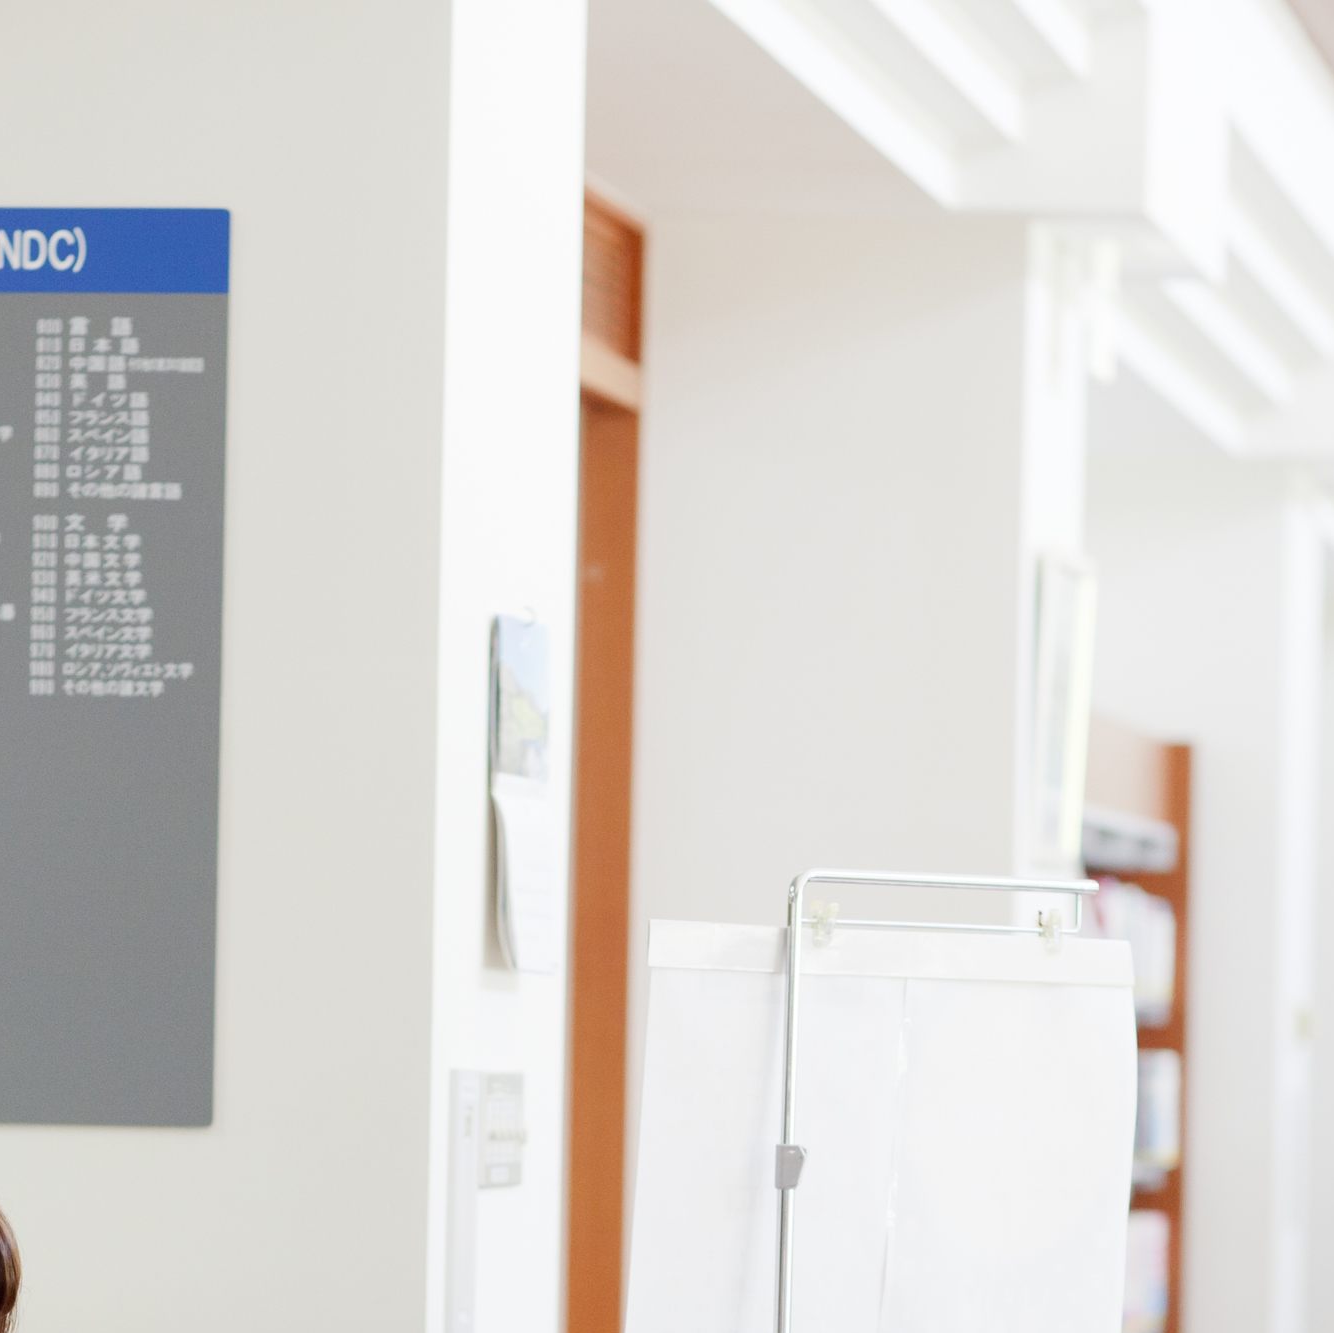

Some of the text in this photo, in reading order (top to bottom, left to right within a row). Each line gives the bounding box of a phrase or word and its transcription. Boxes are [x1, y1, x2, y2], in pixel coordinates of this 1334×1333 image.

[67, 392, 150, 409] ドイツ語
[67, 410, 150, 428] フランス語
[66, 426, 150, 445] スペイン語
[65, 514, 129, 532] 文学
[65, 534, 142, 550] 日本文学
[64, 608, 154, 622] フランス文学
[64, 626, 153, 640] スペイン文学
